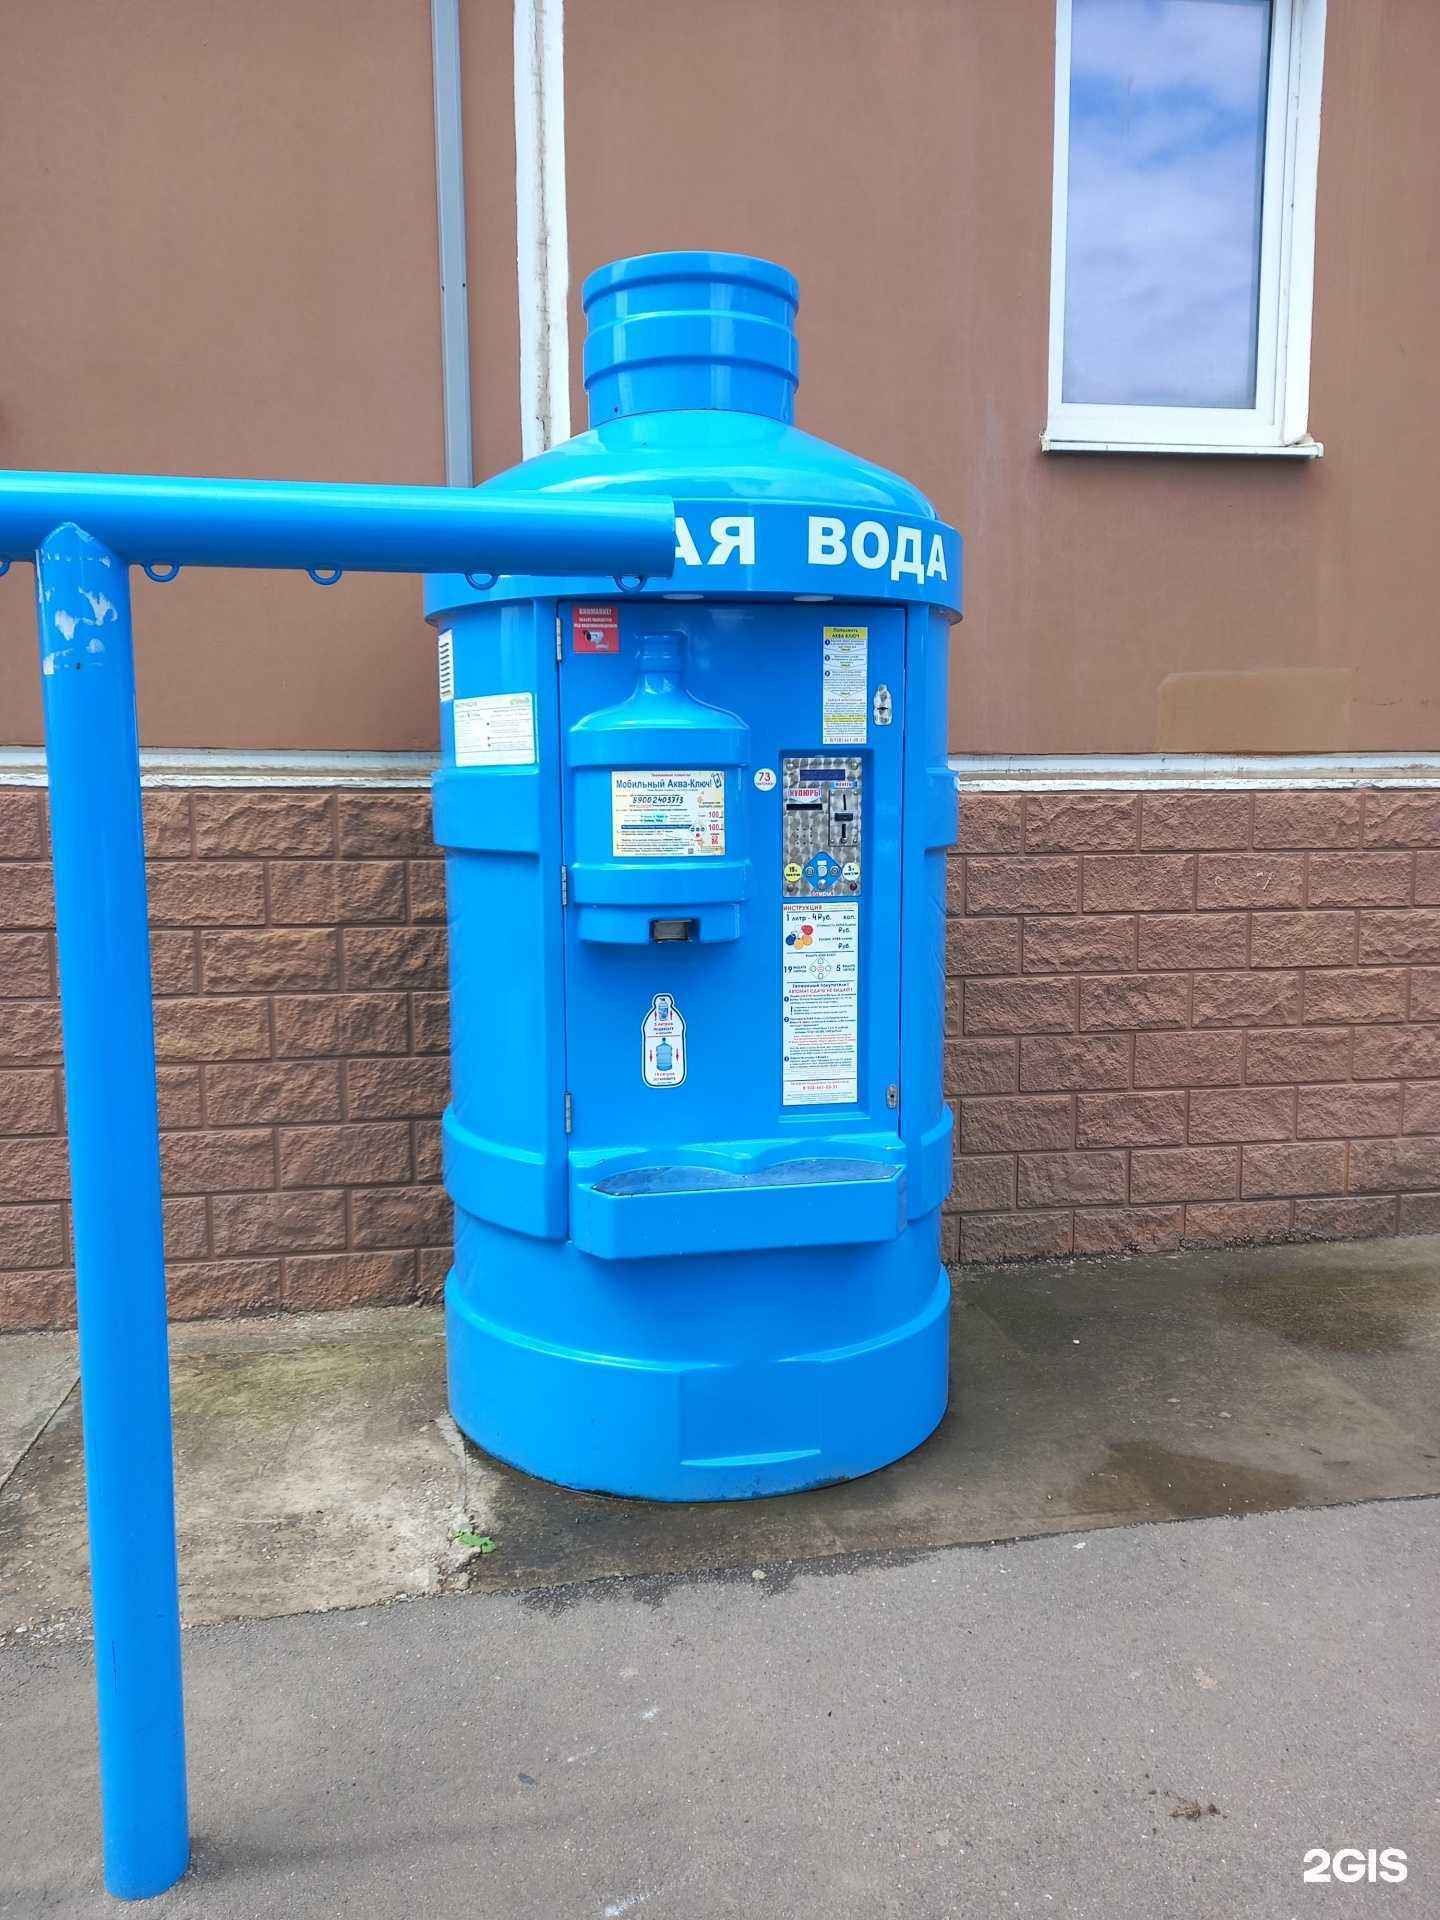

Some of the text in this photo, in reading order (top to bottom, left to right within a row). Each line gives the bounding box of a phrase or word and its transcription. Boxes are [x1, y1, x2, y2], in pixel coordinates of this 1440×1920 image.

[675, 516, 949, 585] АЯ ВОДА
[758, 772, 771, 782] 73
[616, 778, 712, 789] Мобильный Аква-Ключ!
[708, 823, 720, 831] 100
[836, 964, 841, 972] 5
